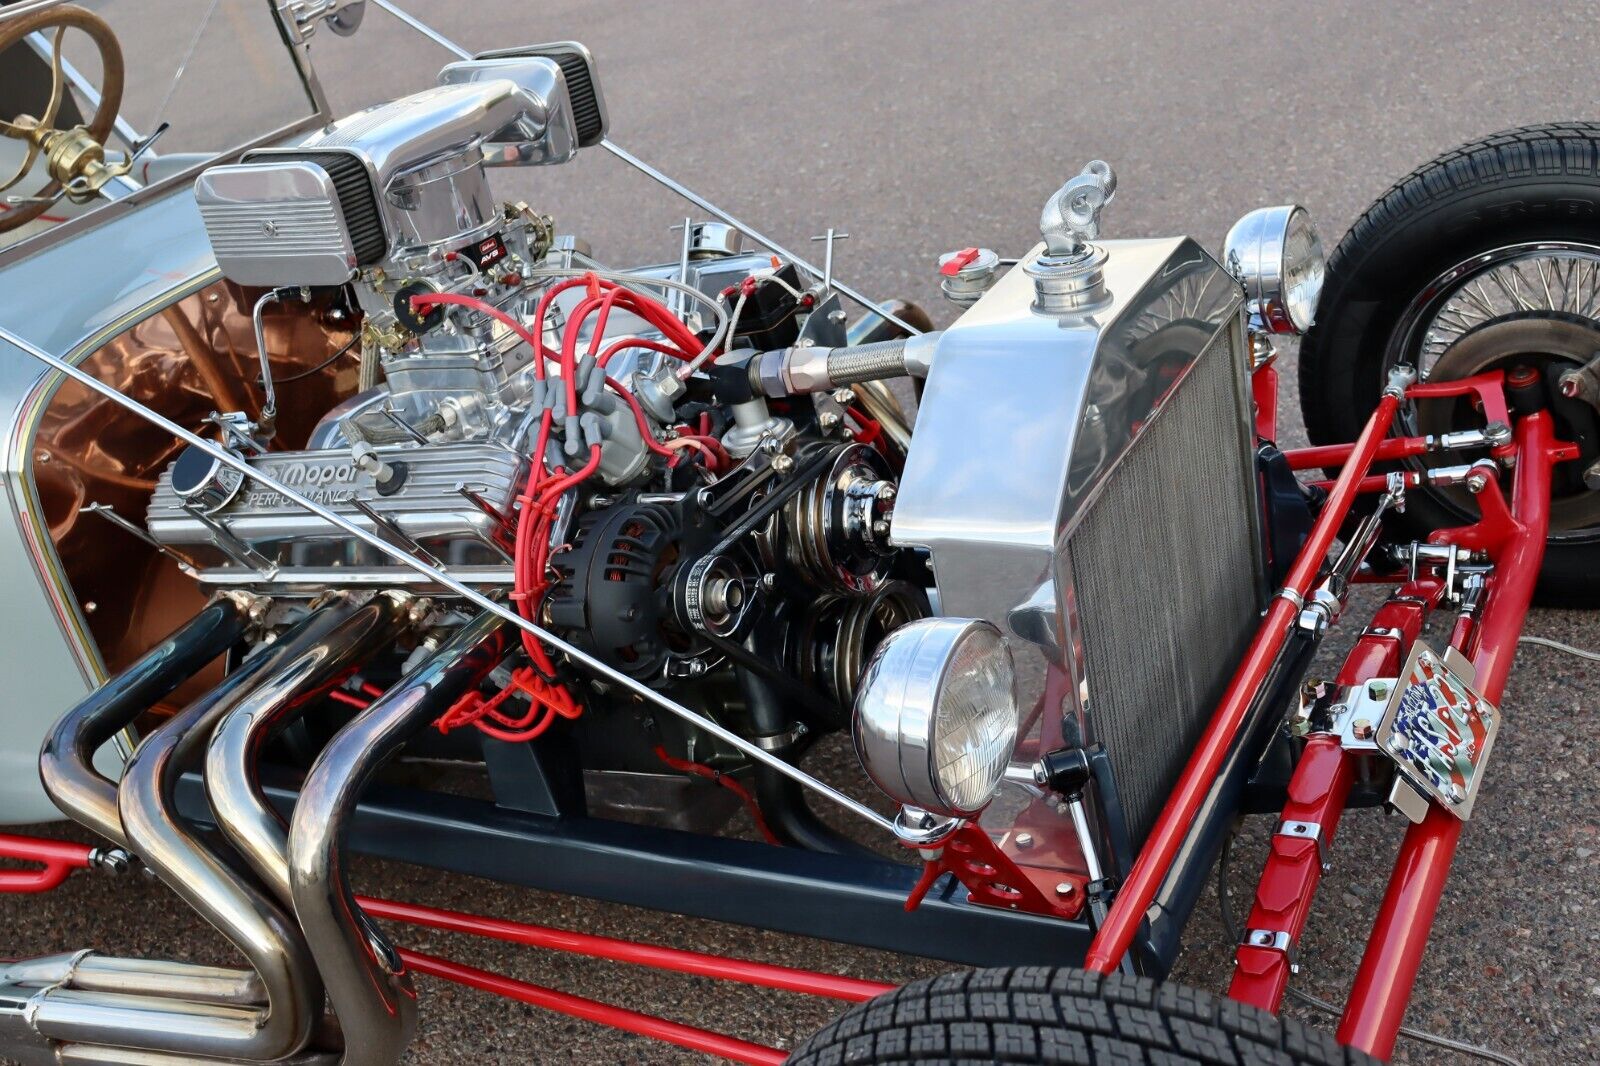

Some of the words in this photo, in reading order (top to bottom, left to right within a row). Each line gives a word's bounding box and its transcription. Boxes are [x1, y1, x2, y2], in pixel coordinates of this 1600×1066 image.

[282, 462, 357, 487] Mopar
[249, 489, 355, 506] PERFOMANCE
[1404, 684, 1427, 720] ARIZONA
